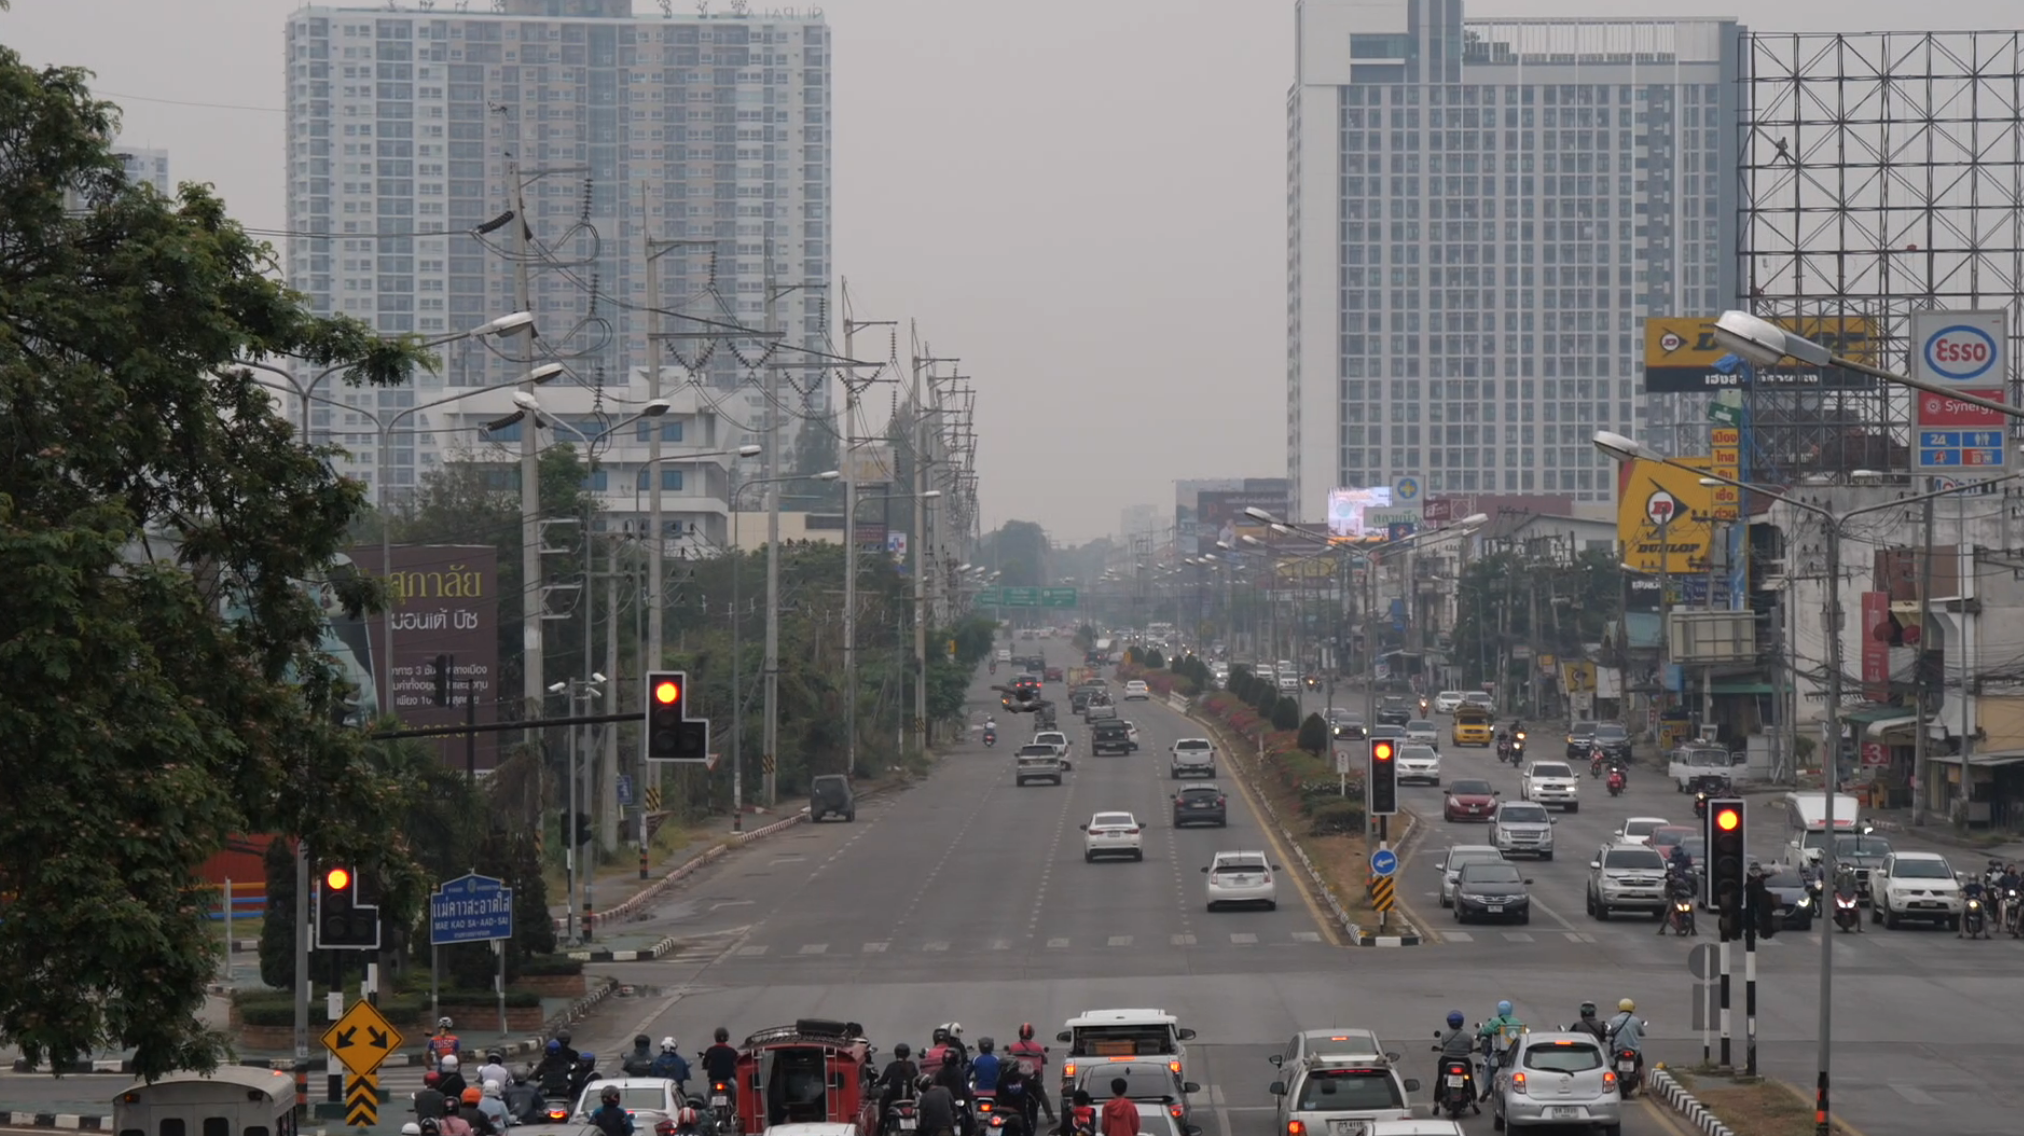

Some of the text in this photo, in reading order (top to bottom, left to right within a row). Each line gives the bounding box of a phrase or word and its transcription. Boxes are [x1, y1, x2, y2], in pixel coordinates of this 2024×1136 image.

[1936, 338, 1987, 362] Esso
[434, 921, 449, 930] MAE
[450, 920, 465, 930] KAO
